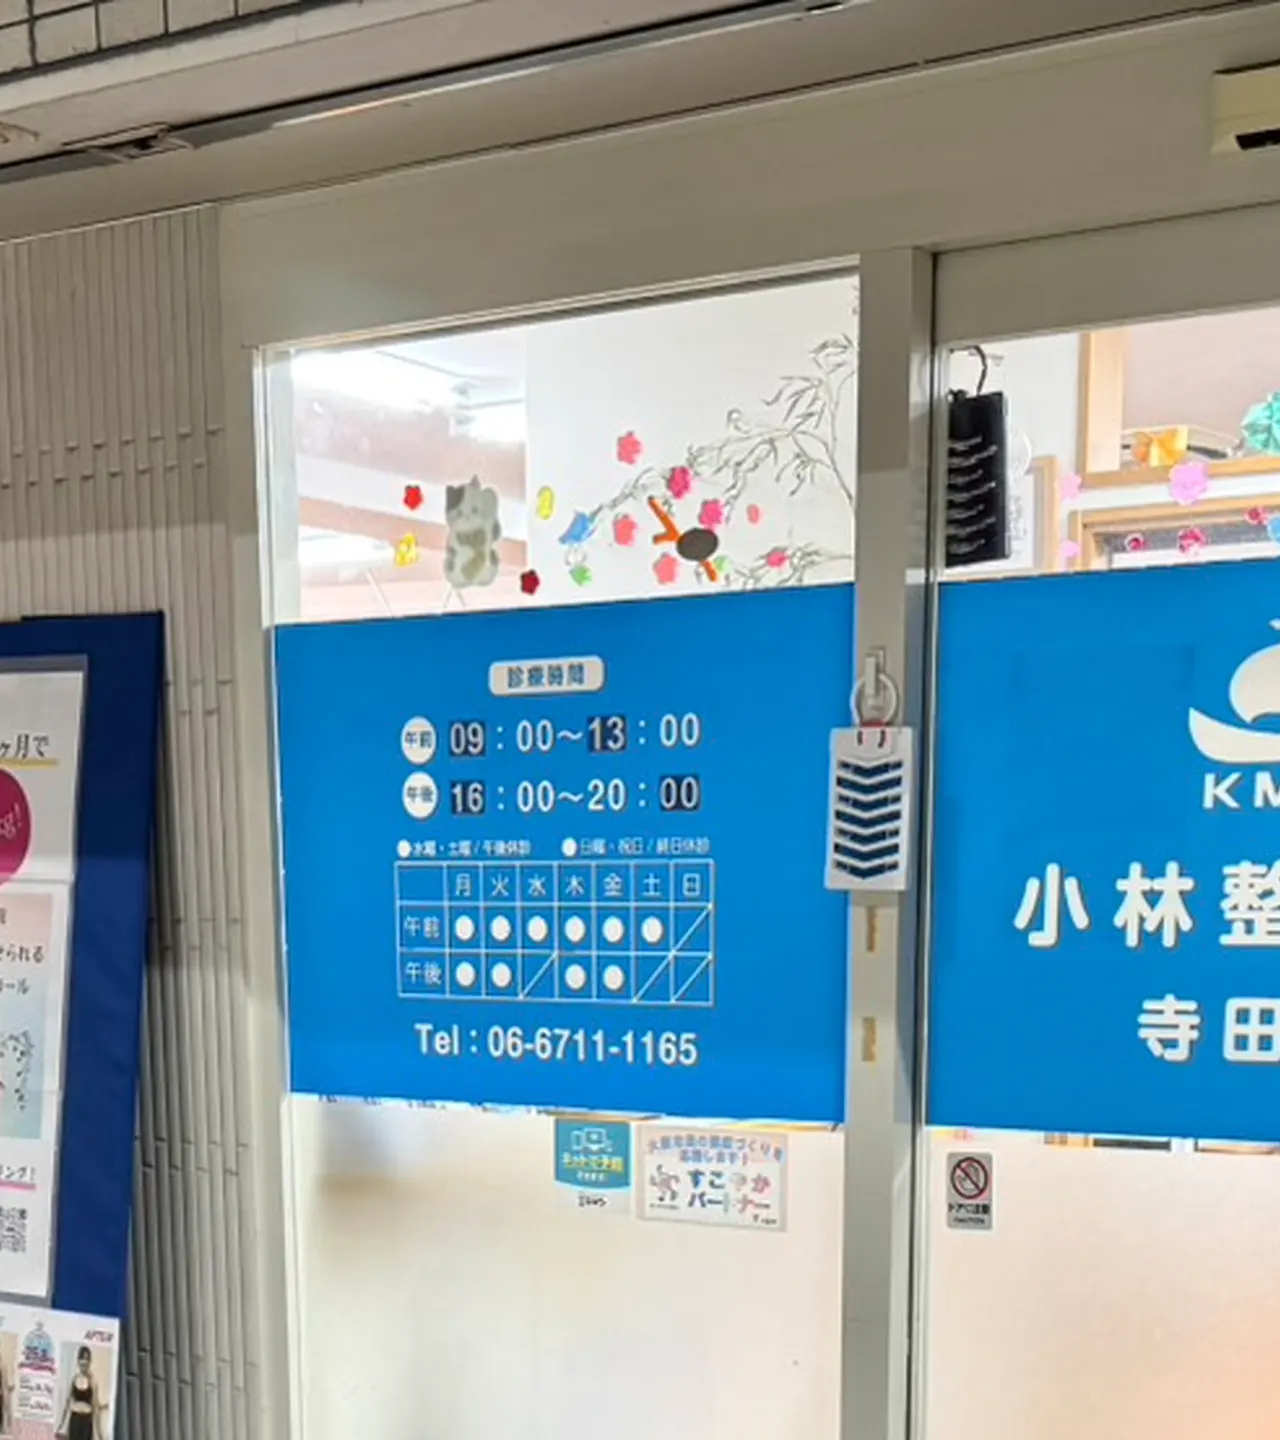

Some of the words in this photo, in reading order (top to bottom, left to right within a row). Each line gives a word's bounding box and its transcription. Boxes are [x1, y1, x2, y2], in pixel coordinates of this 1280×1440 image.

[507, 663, 585, 688] 診療時間
[405, 730, 433, 749] 午前
[407, 785, 435, 805] 午後
[454, 873, 472, 897] 月
[490, 873, 510, 897] 火
[527, 873, 548, 897] 水
[564, 873, 586, 897] 木
[603, 872, 624, 897] 金
[642, 873, 662, 897] 土
[682, 873, 701, 898] 日
[403, 915, 441, 939] 午前
[404, 961, 443, 986] 午後
[487, 1025, 699, 1067] 06-6711-1165
